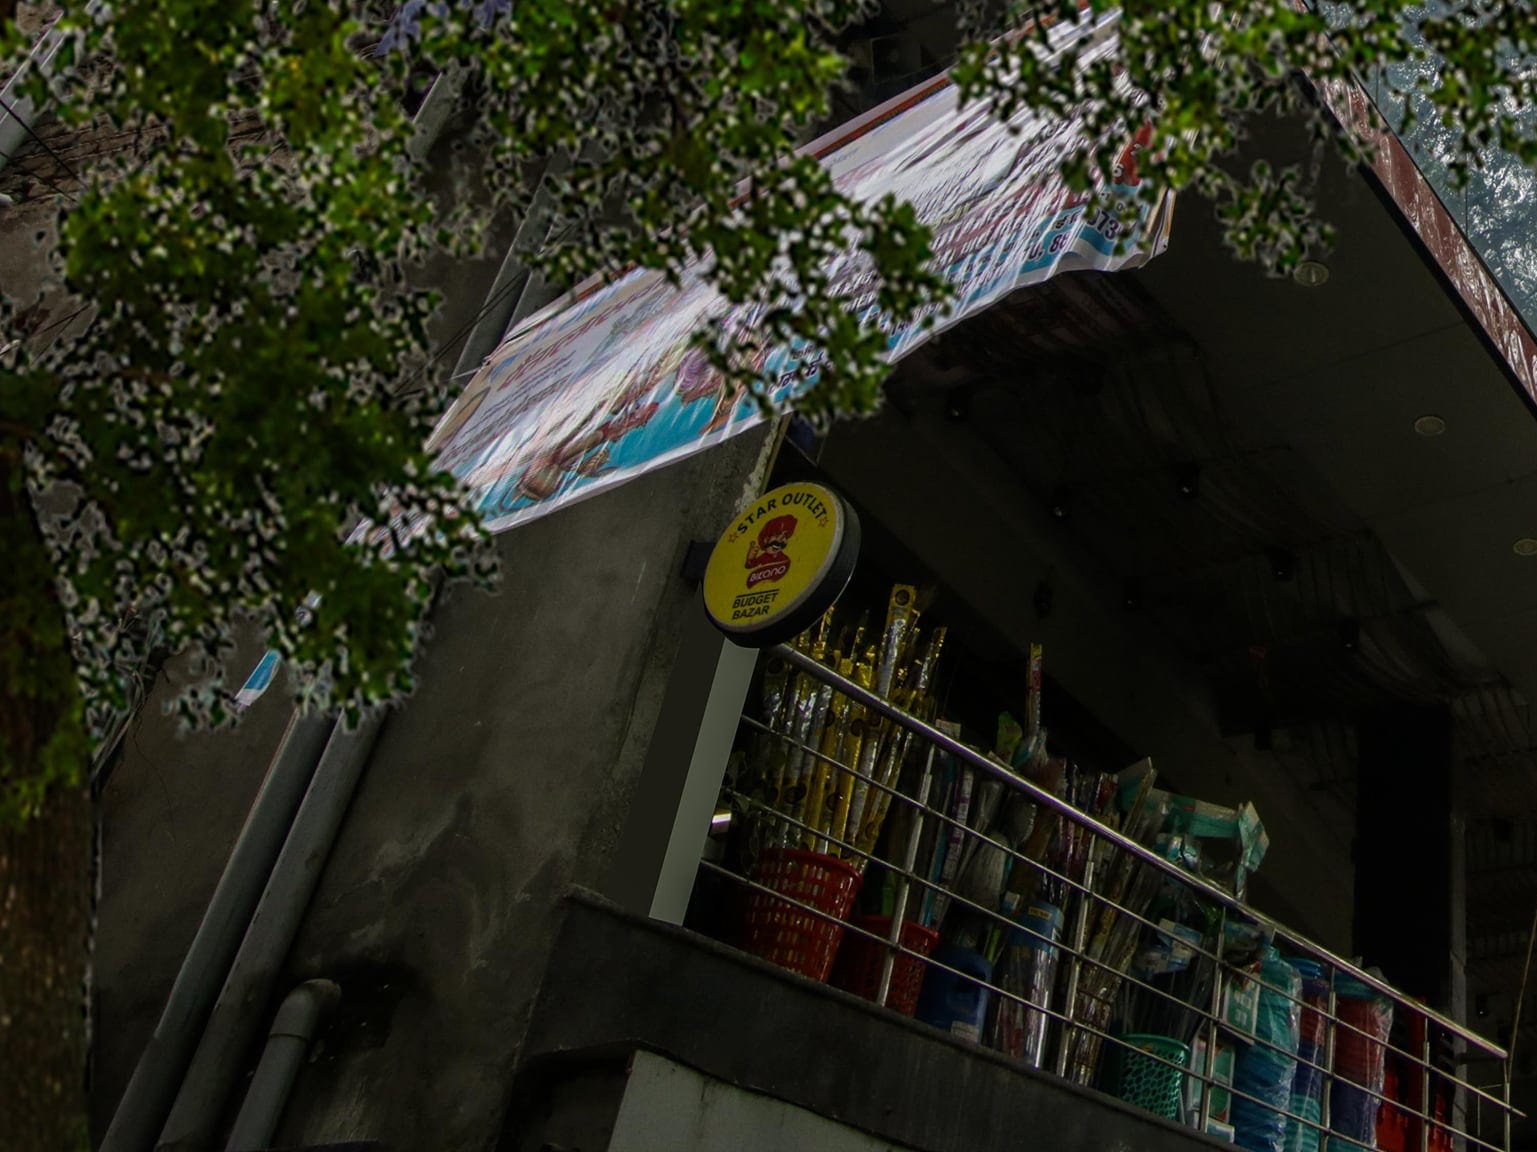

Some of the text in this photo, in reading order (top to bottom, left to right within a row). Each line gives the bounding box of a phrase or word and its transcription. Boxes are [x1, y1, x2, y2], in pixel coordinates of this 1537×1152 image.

[737, 492, 827, 534] STAR OUTLET
[733, 593, 778, 608] BUDGET
[732, 606, 769, 619] BAZAR
